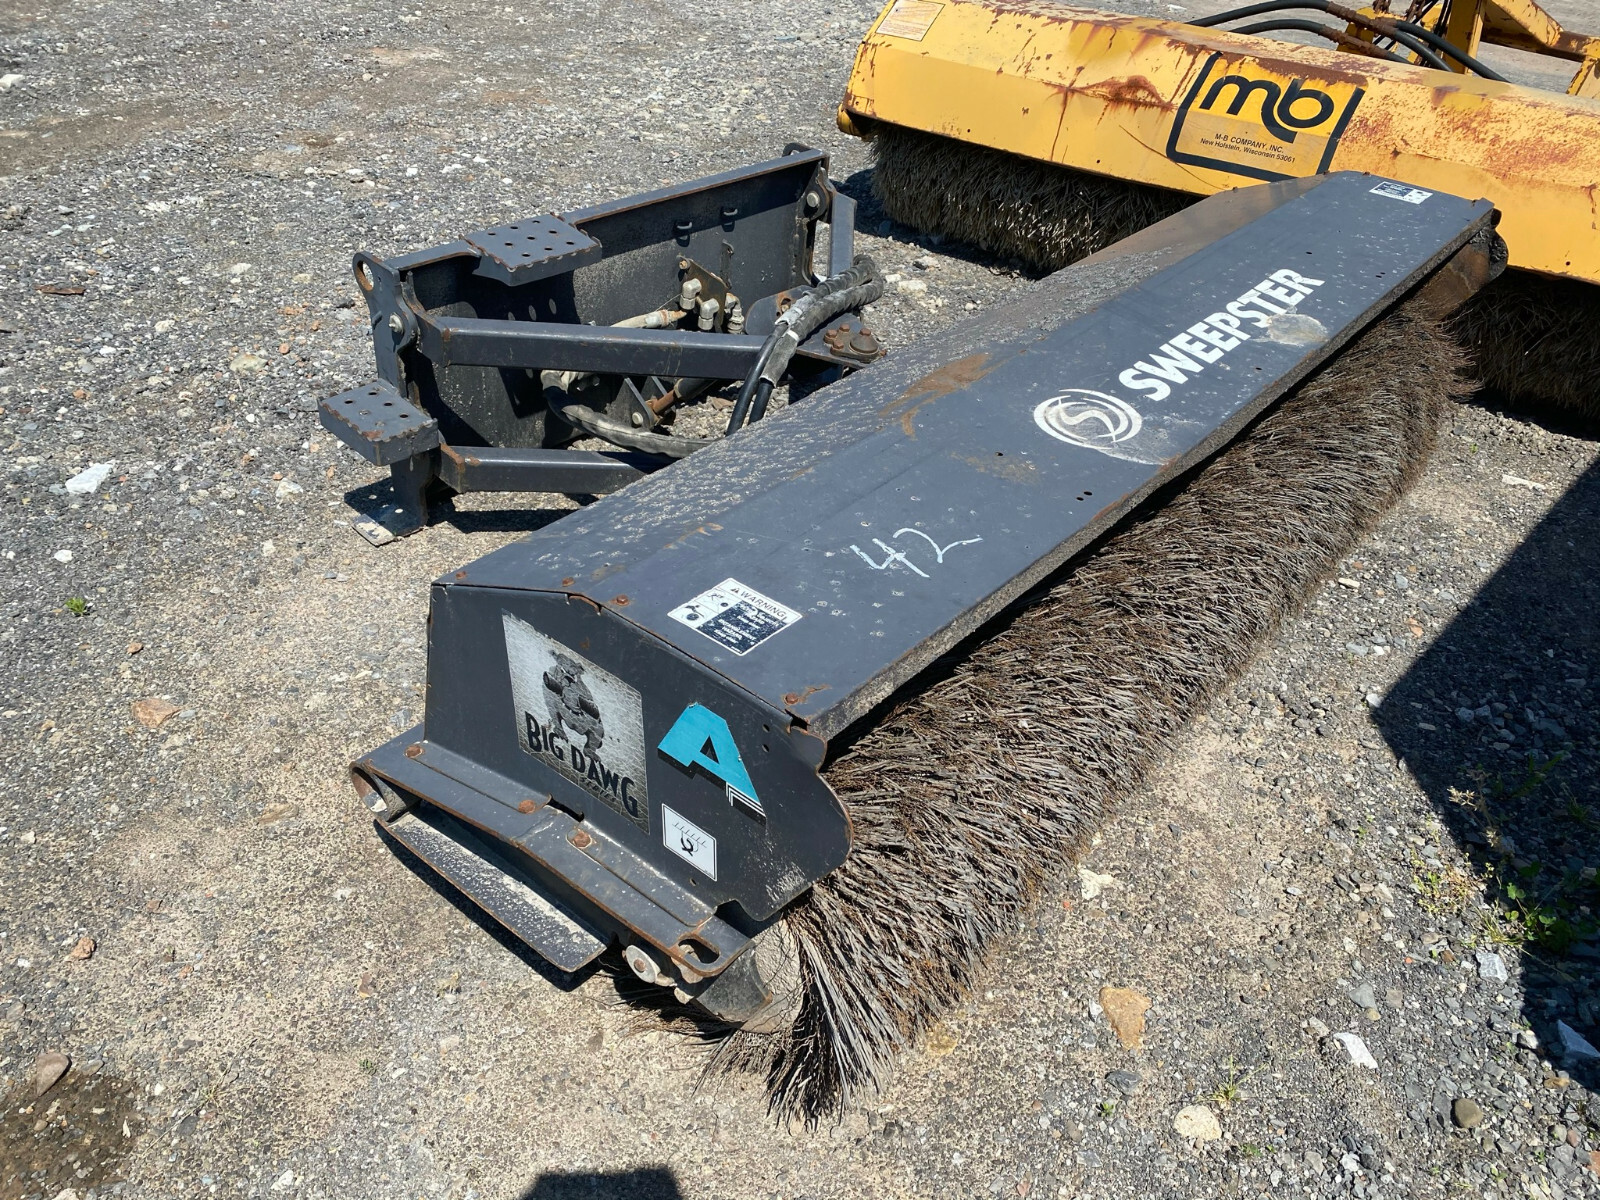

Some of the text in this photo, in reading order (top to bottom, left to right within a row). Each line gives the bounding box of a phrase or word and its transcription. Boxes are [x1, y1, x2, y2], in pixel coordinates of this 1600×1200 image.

[1199, 75, 1334, 144] mb
[1200, 138, 1214, 146] New
[1243, 146, 1275, 159] Wisconsin
[1276, 153, 1296, 163] 53061
[1215, 133, 1229, 142] M-B
[1269, 144, 1284, 153] INC.
[1118, 268, 1325, 401] SWEEPSTER
[850, 527, 983, 578] 42
[740, 590, 788, 618] WARNING
[524, 711, 639, 819] BIG DAWG
